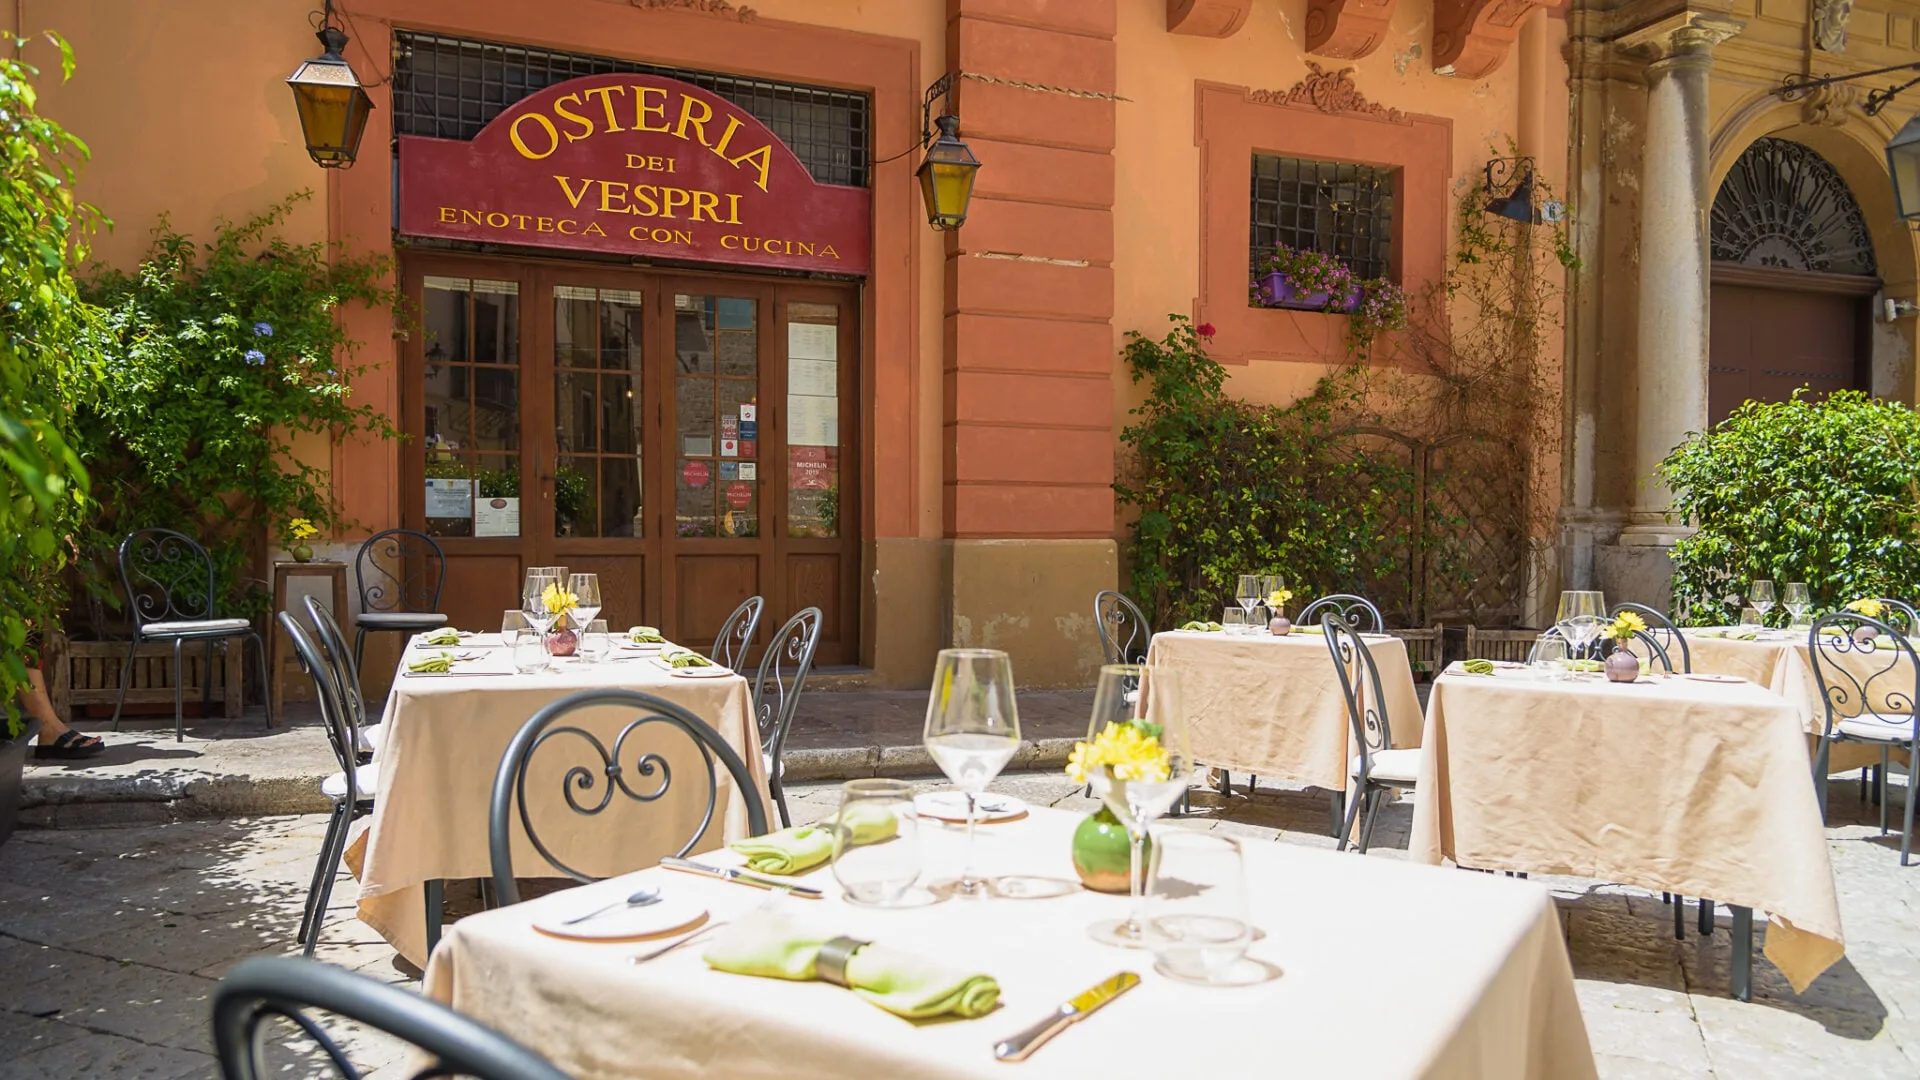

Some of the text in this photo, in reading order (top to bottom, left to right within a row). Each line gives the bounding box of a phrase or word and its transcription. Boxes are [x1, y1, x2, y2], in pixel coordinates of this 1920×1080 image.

[509, 85, 773, 192] OSTERIA
[625, 153, 676, 174] DEI
[553, 175, 743, 225] VESPRI
[439, 207, 841, 260] ENOTECA CON CUCINA
